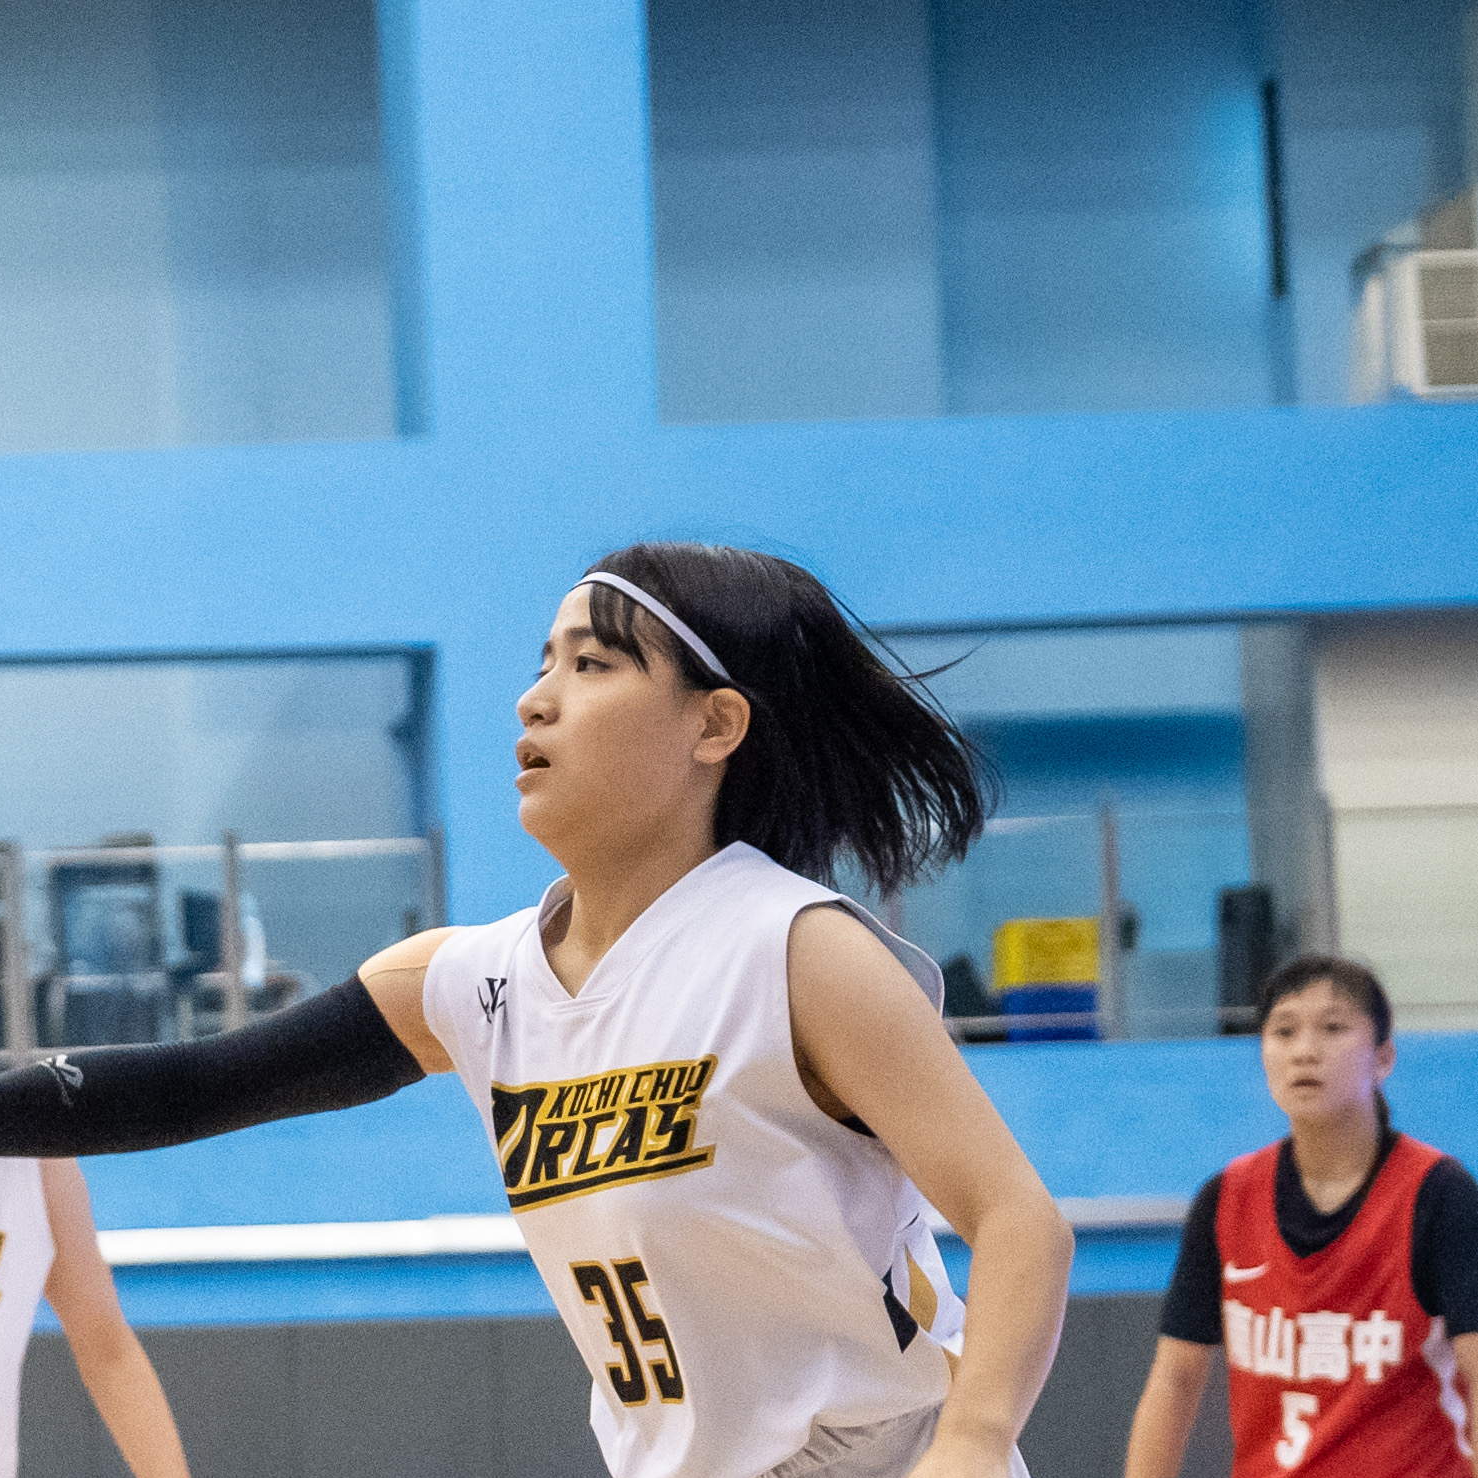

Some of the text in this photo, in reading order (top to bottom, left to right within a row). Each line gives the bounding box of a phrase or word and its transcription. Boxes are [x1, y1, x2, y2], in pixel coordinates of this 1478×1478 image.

[491, 1086, 699, 1188] ORCAS
[547, 1074, 627, 1119] KOCHI
[569, 1258, 685, 1407] 35
[1274, 1390, 1319, 1470] 5
